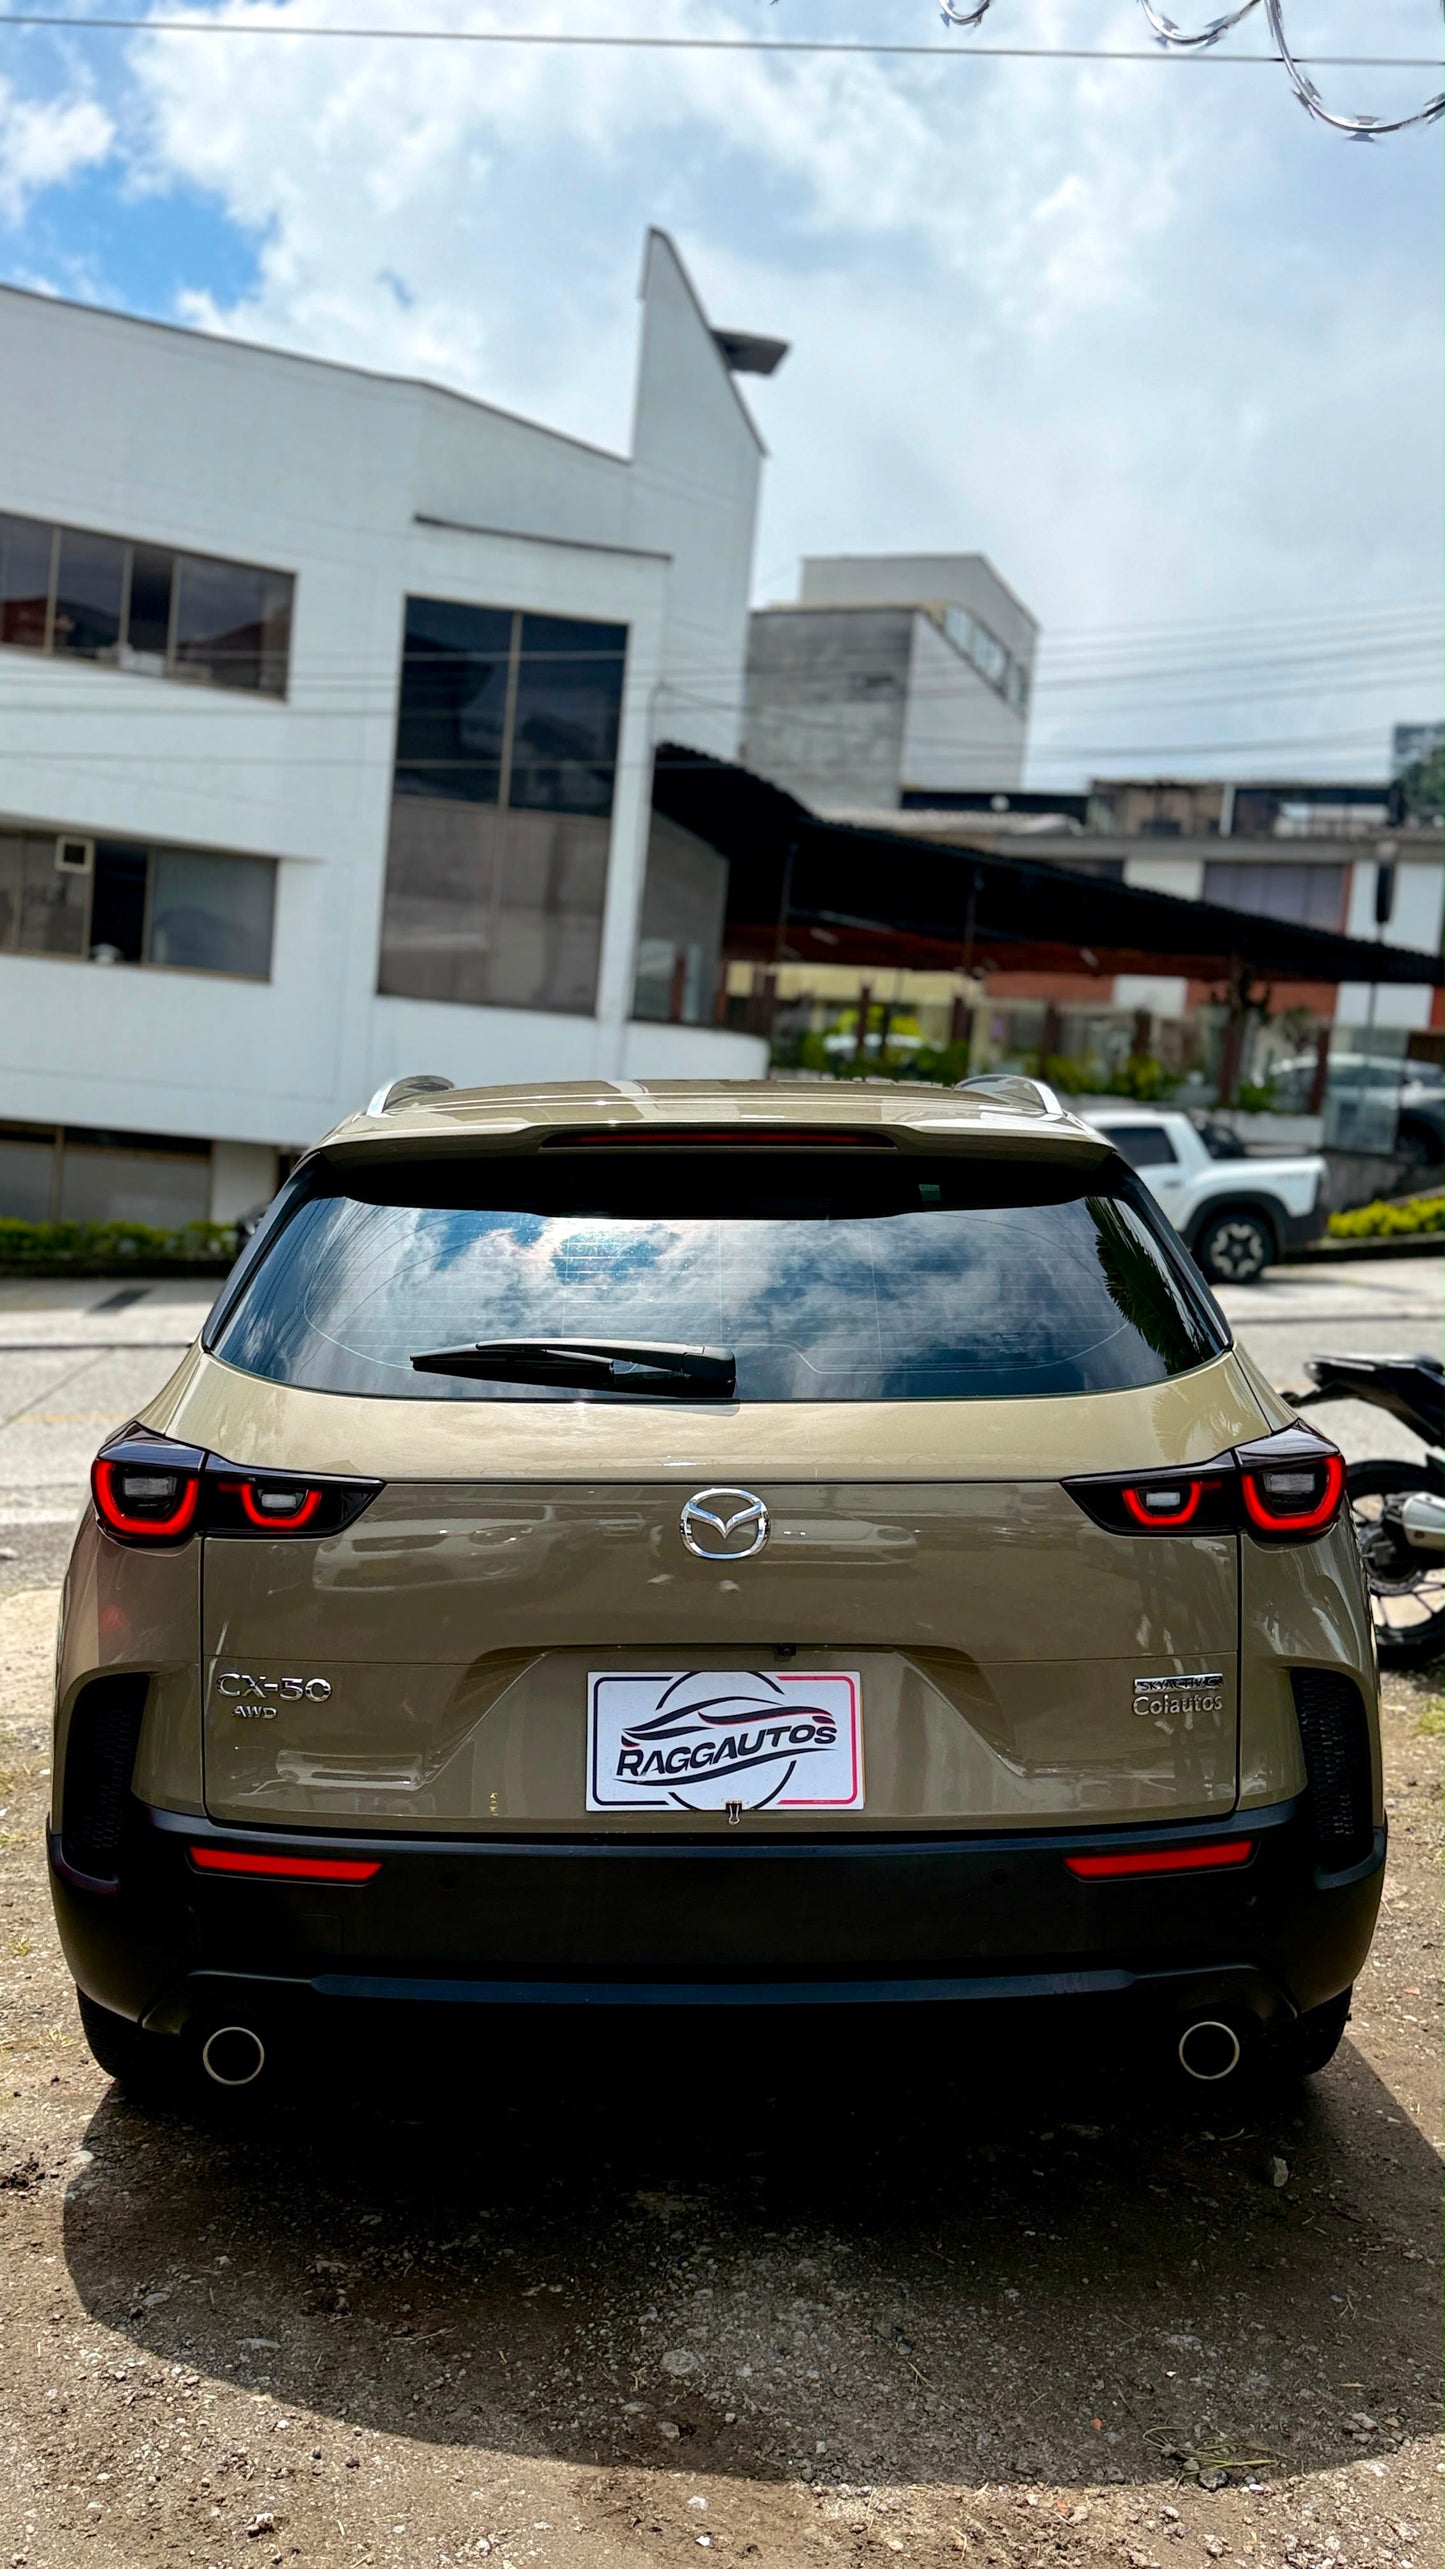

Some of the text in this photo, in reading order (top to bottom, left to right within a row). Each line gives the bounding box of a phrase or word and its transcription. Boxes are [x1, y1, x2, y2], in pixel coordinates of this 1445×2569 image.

[216, 1672, 332, 1702] CX-50
[232, 1704, 277, 1720] AWD
[1132, 1693, 1223, 1716] Colautos
[615, 1724, 838, 1777] RAGGAUTOS
